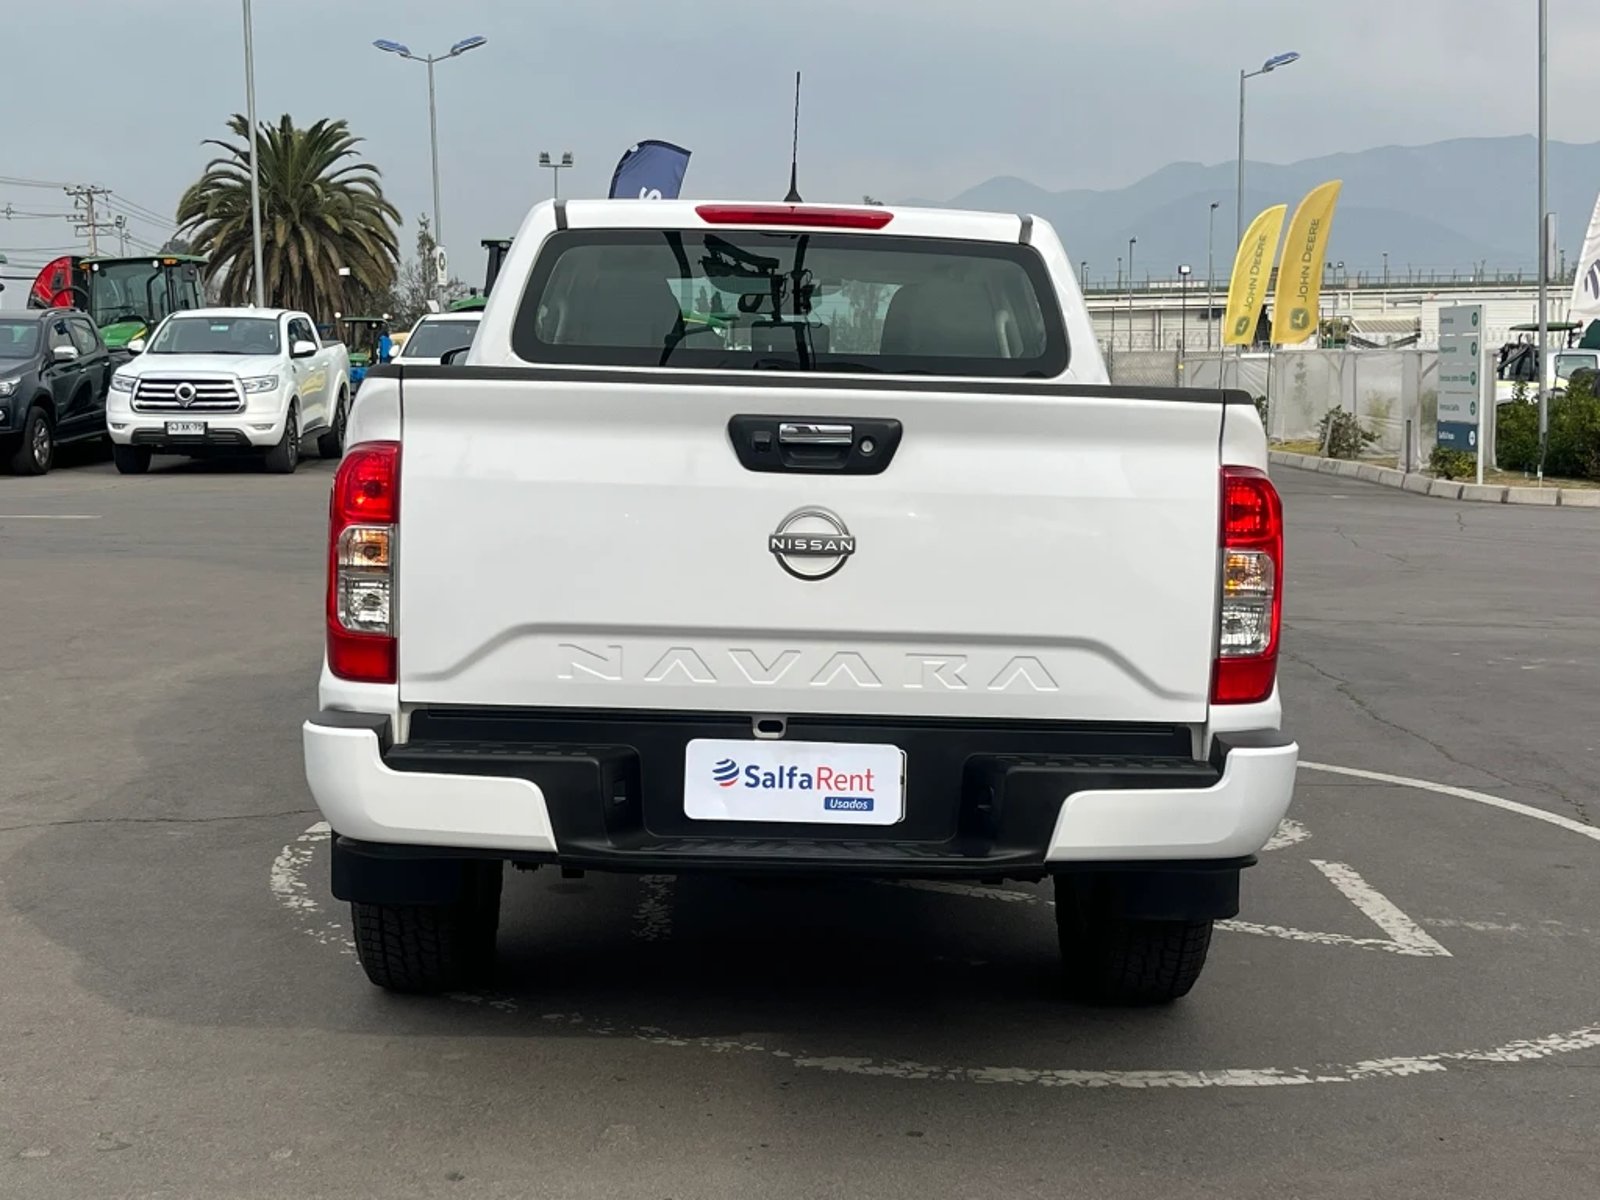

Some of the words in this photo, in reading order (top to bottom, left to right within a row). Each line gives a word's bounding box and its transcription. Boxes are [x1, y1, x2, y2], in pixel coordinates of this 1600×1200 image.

[1249, 235, 1268, 276] DEERE
[1302, 219, 1320, 263] DEERE
[1244, 277, 1258, 312] JOHN
[1297, 266, 1311, 302] JOHN
[771, 537, 854, 551] NISSAN
[557, 643, 1060, 691] NAVARA
[744, 764, 875, 792] SalfaRent
[829, 798, 868, 811] Usados
